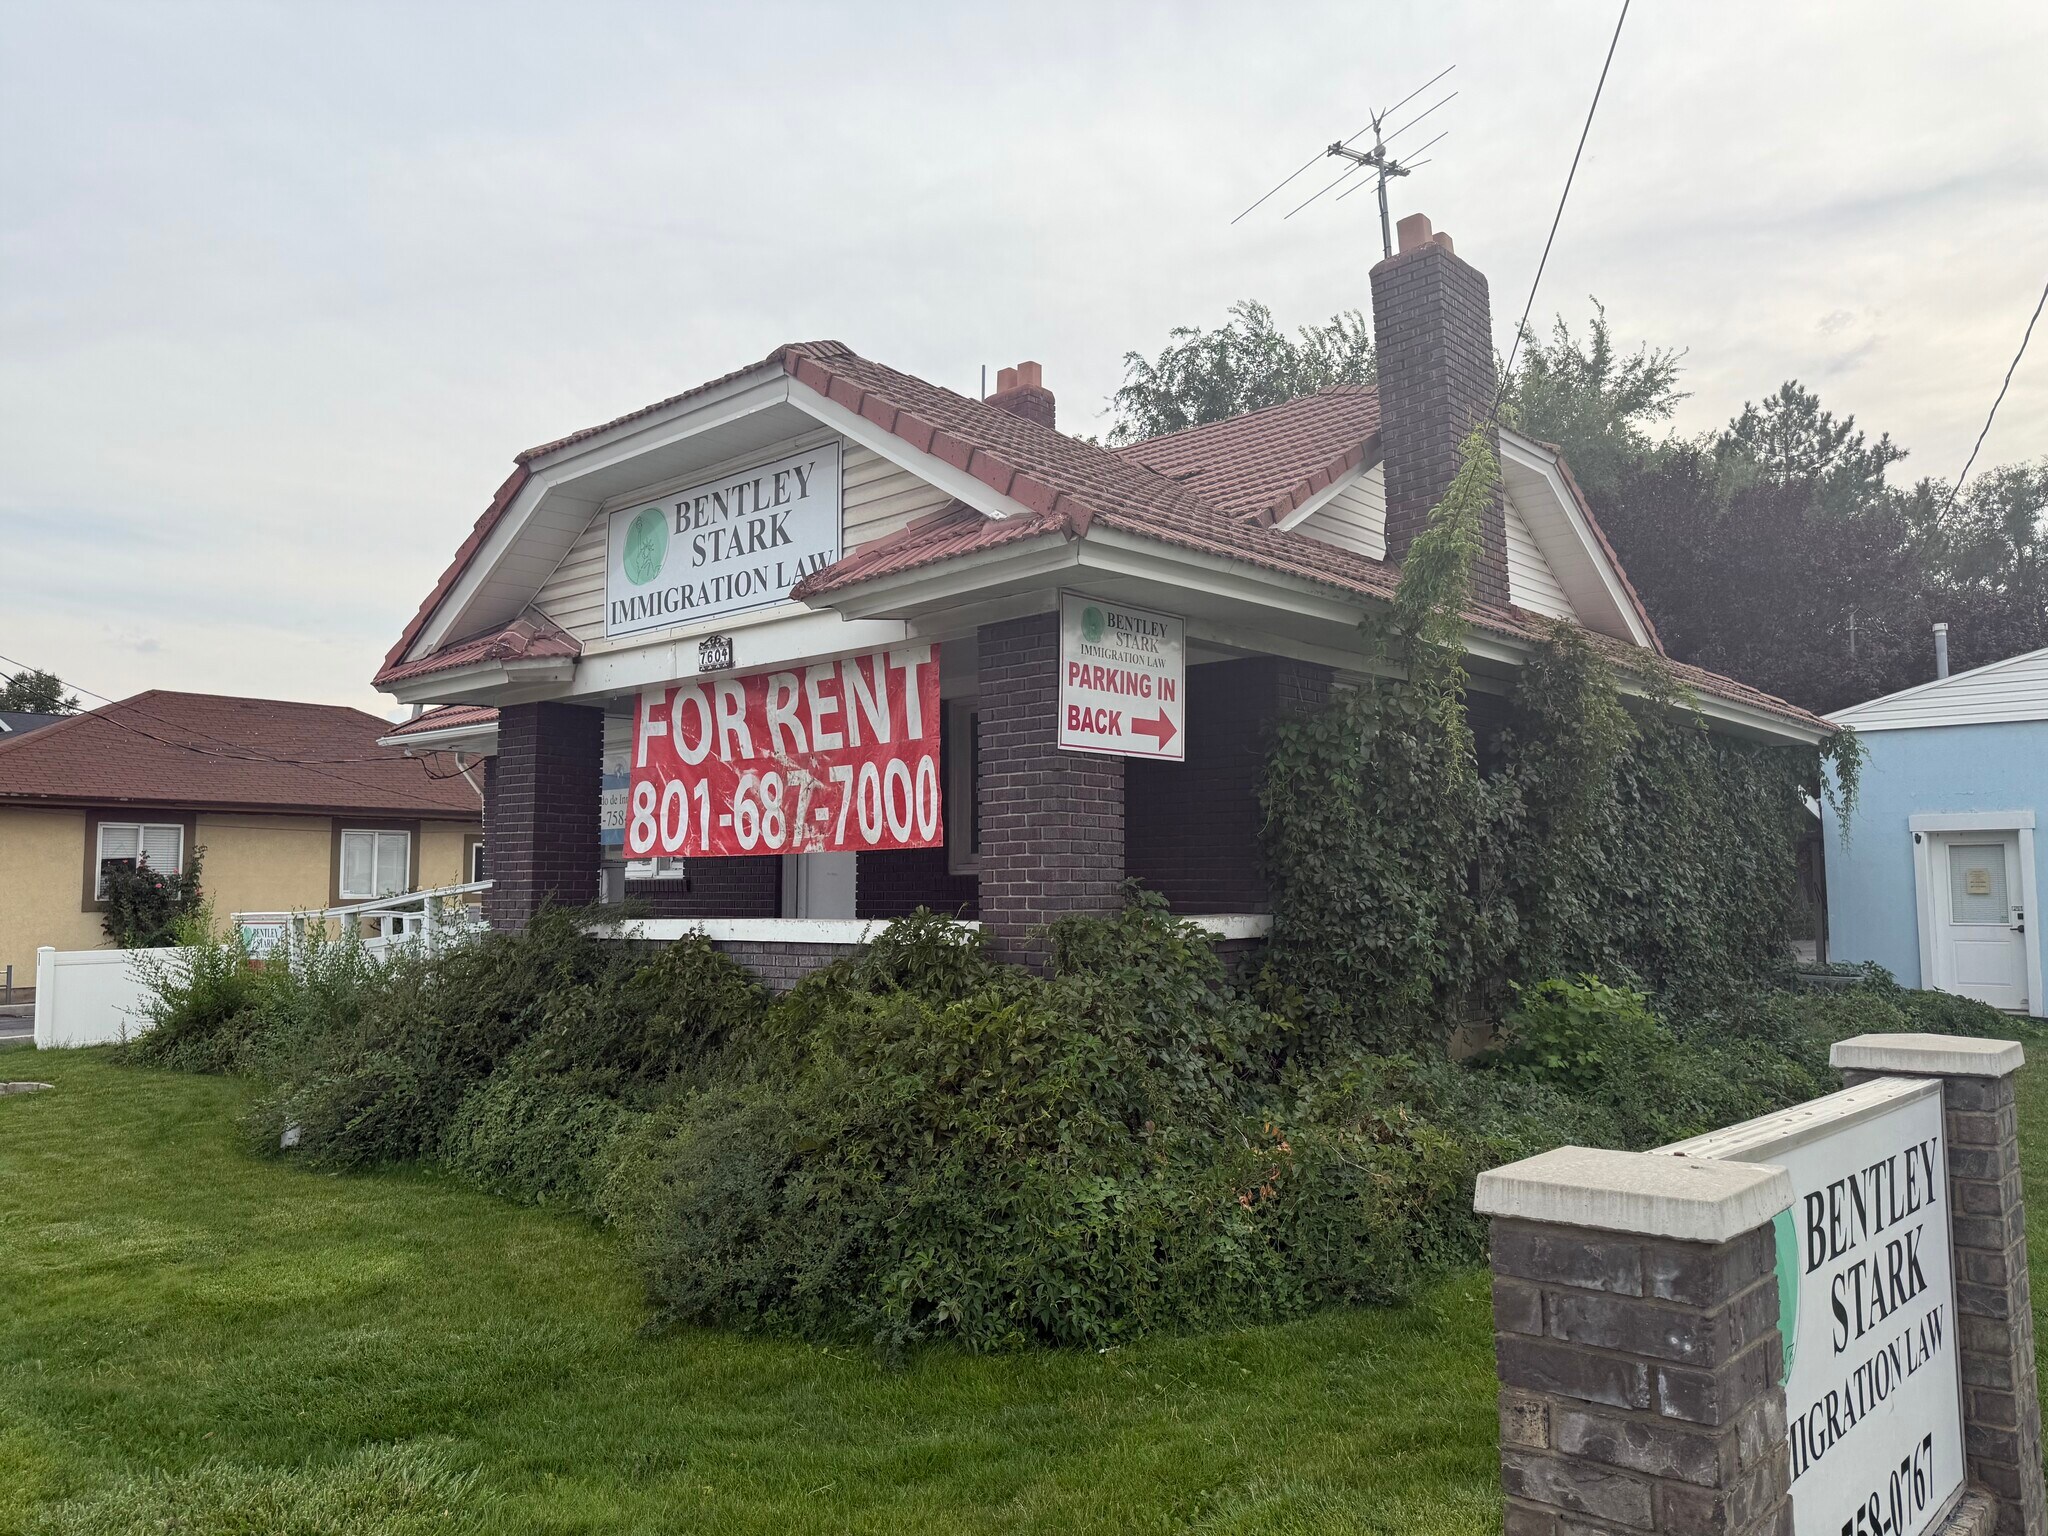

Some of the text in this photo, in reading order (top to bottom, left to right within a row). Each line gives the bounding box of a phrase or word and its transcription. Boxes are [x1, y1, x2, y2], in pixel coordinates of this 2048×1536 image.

[673, 461, 816, 536] BENTLEY
[692, 509, 793, 568] STARK
[611, 549, 834, 626] IMMIGRATION LAW
[700, 648, 728, 665] 7604
[1080, 643, 1167, 669] IMMIGRATION LAW
[1107, 611, 1168, 639] BENTLEY
[1116, 631, 1160, 654] STARK
[636, 645, 932, 769] FOR RENT
[1068, 661, 1176, 702] PARKING IN
[1067, 704, 1123, 737] BACK
[629, 755, 938, 854] 801-687-7000
[1803, 1137, 1938, 1276] BENTLEY
[1831, 1223, 1928, 1358] STARK
[1907, 1304, 1945, 1378] LAW
